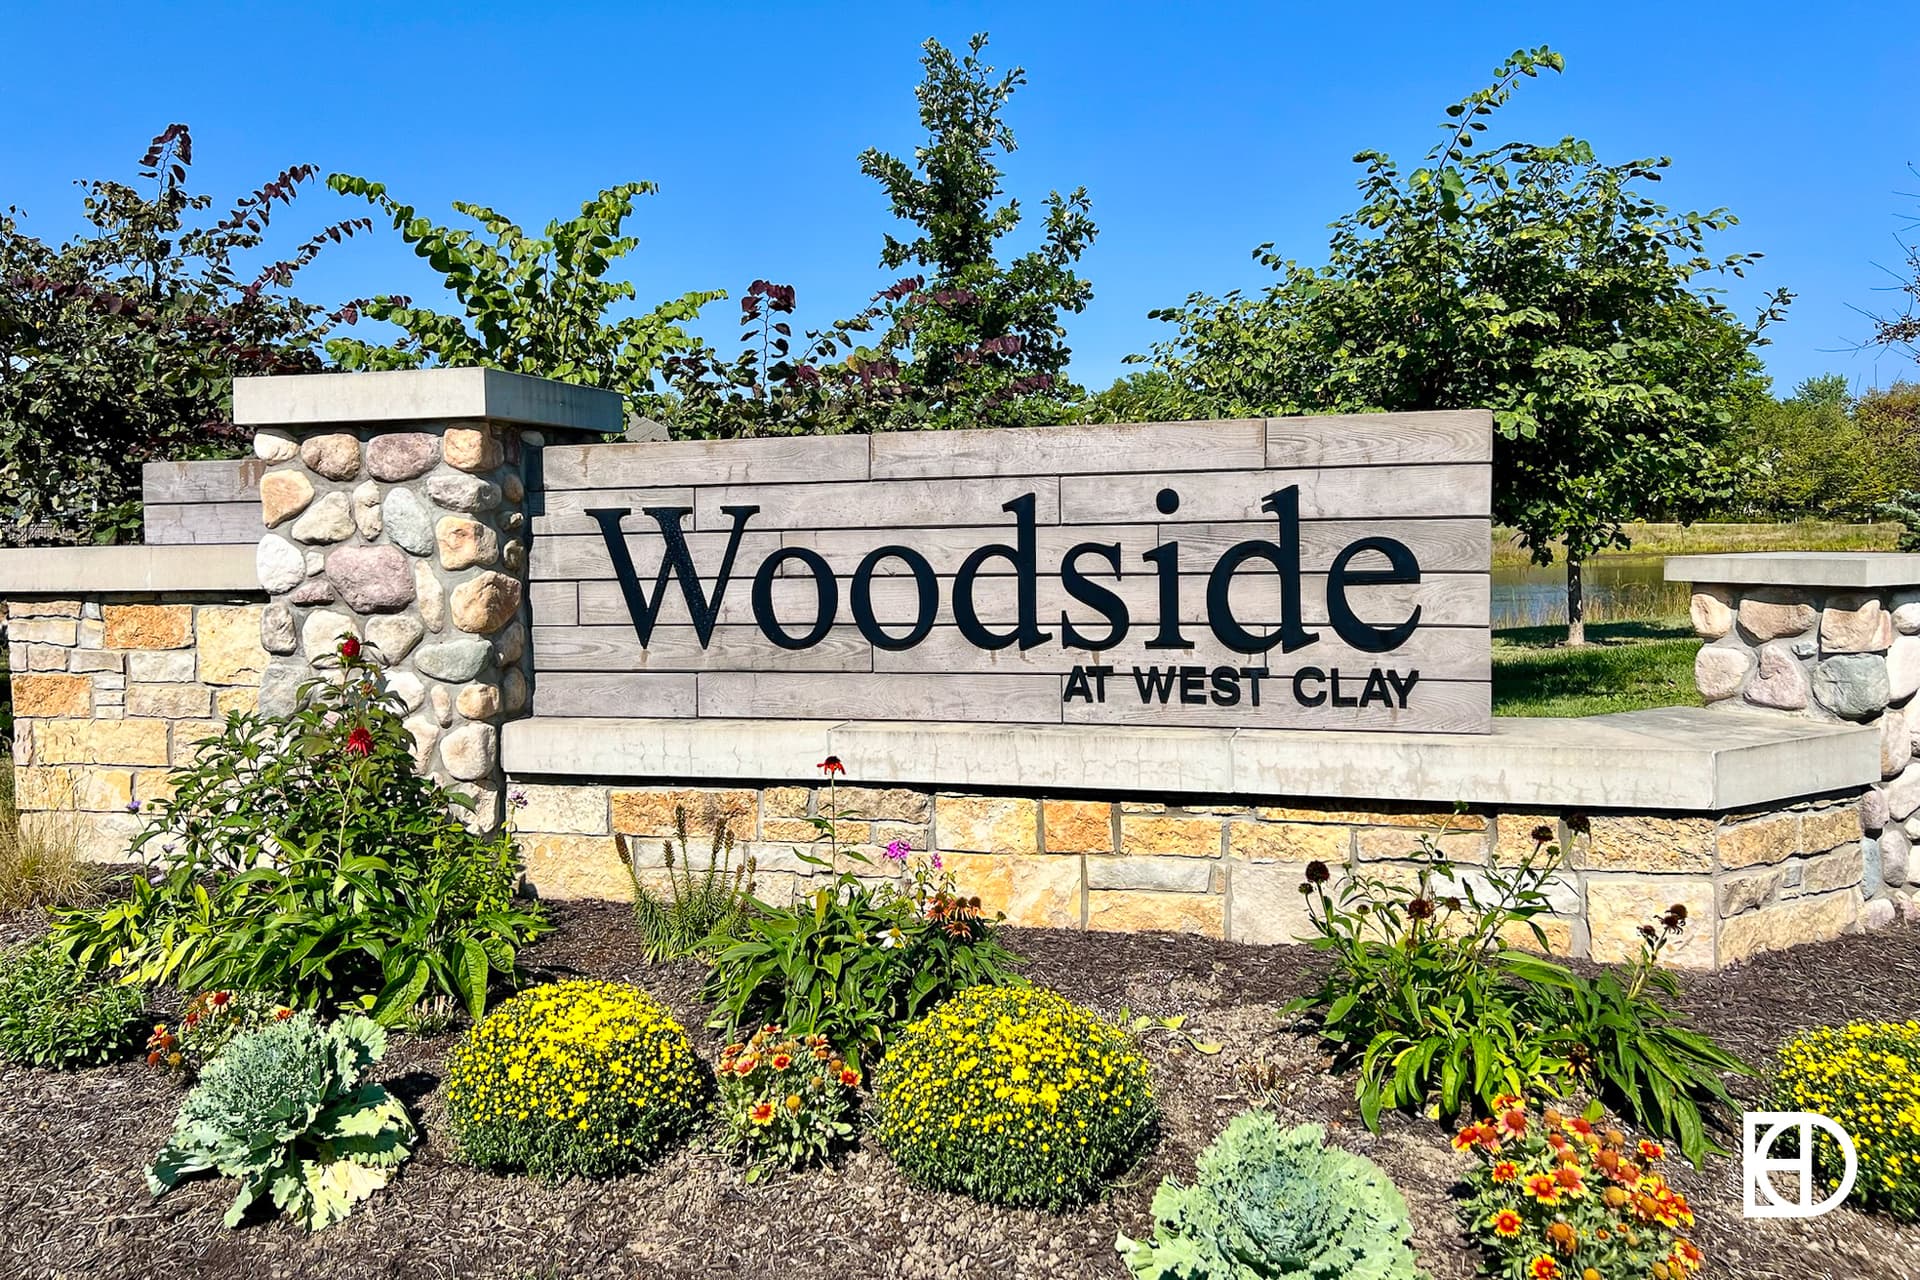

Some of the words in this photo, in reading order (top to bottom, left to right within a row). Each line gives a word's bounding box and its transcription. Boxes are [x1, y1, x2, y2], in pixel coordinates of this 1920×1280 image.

[584, 484, 1422, 654] Woodside
[1063, 665, 1114, 703] AT
[1132, 665, 1269, 707] WEST
[1293, 666, 1419, 709] CLAY
